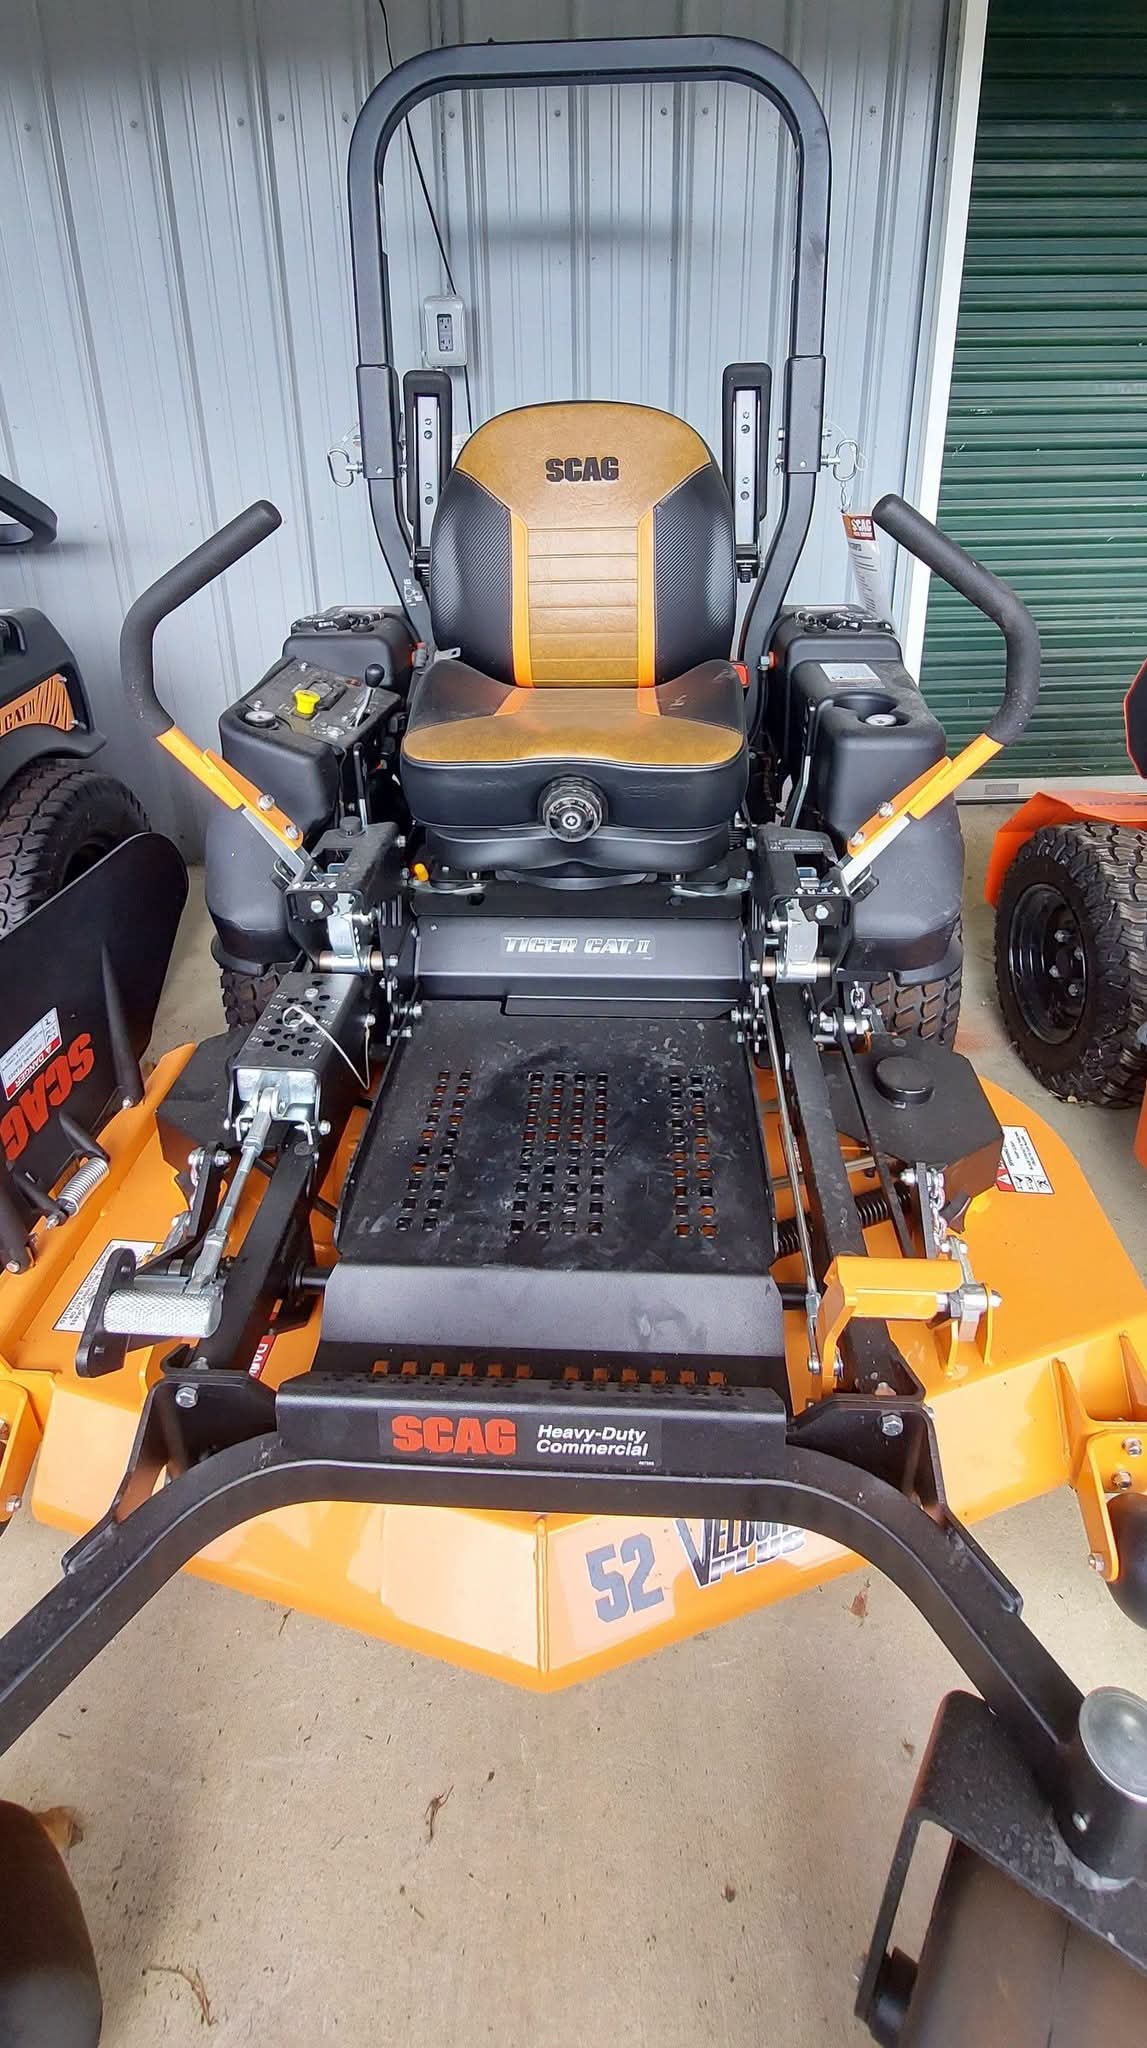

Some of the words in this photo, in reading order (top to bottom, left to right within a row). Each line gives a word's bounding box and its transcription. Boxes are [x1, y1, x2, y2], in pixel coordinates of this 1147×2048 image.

[545, 456, 619, 482] SCAG
[4, 703, 28, 730] CAT
[504, 937, 577, 953] TIGER
[636, 939, 651, 953] II
[14, 1052, 45, 1088] DANGER
[0, 1033, 95, 1161] SCAG
[391, 1415, 517, 1456] SCAG
[536, 1439, 649, 1456] Commercial
[538, 1424, 647, 1444] Heavy-Duty
[585, 1533, 665, 1623] 52
